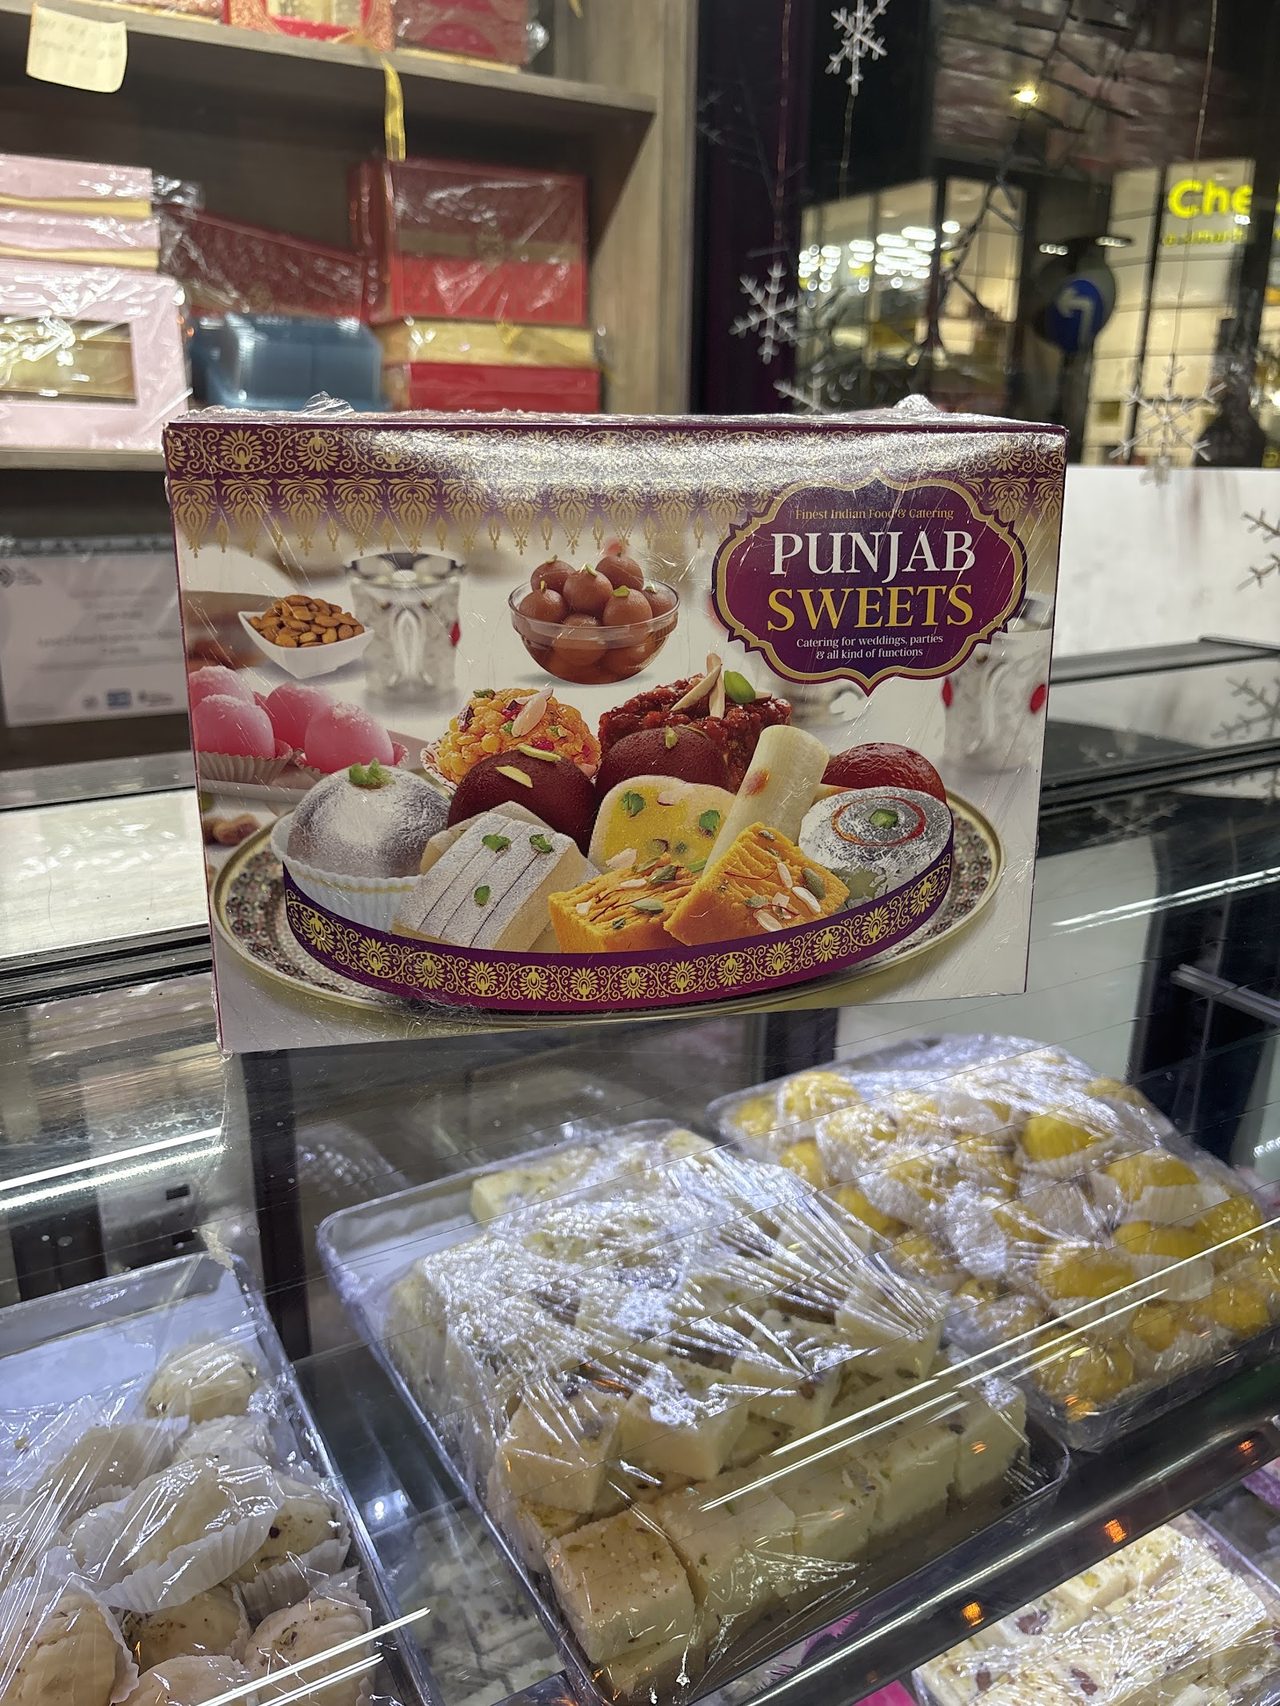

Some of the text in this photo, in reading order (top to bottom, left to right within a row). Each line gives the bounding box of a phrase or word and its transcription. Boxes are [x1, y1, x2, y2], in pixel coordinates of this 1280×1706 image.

[795, 508, 954, 520] Finest Indian Food & Catering
[770, 530, 976, 584] PUNJAB
[767, 584, 974, 632] SWEETS
[796, 634, 944, 649] Catering for weddings, parties
[815, 647, 924, 660] & all kind of functions
